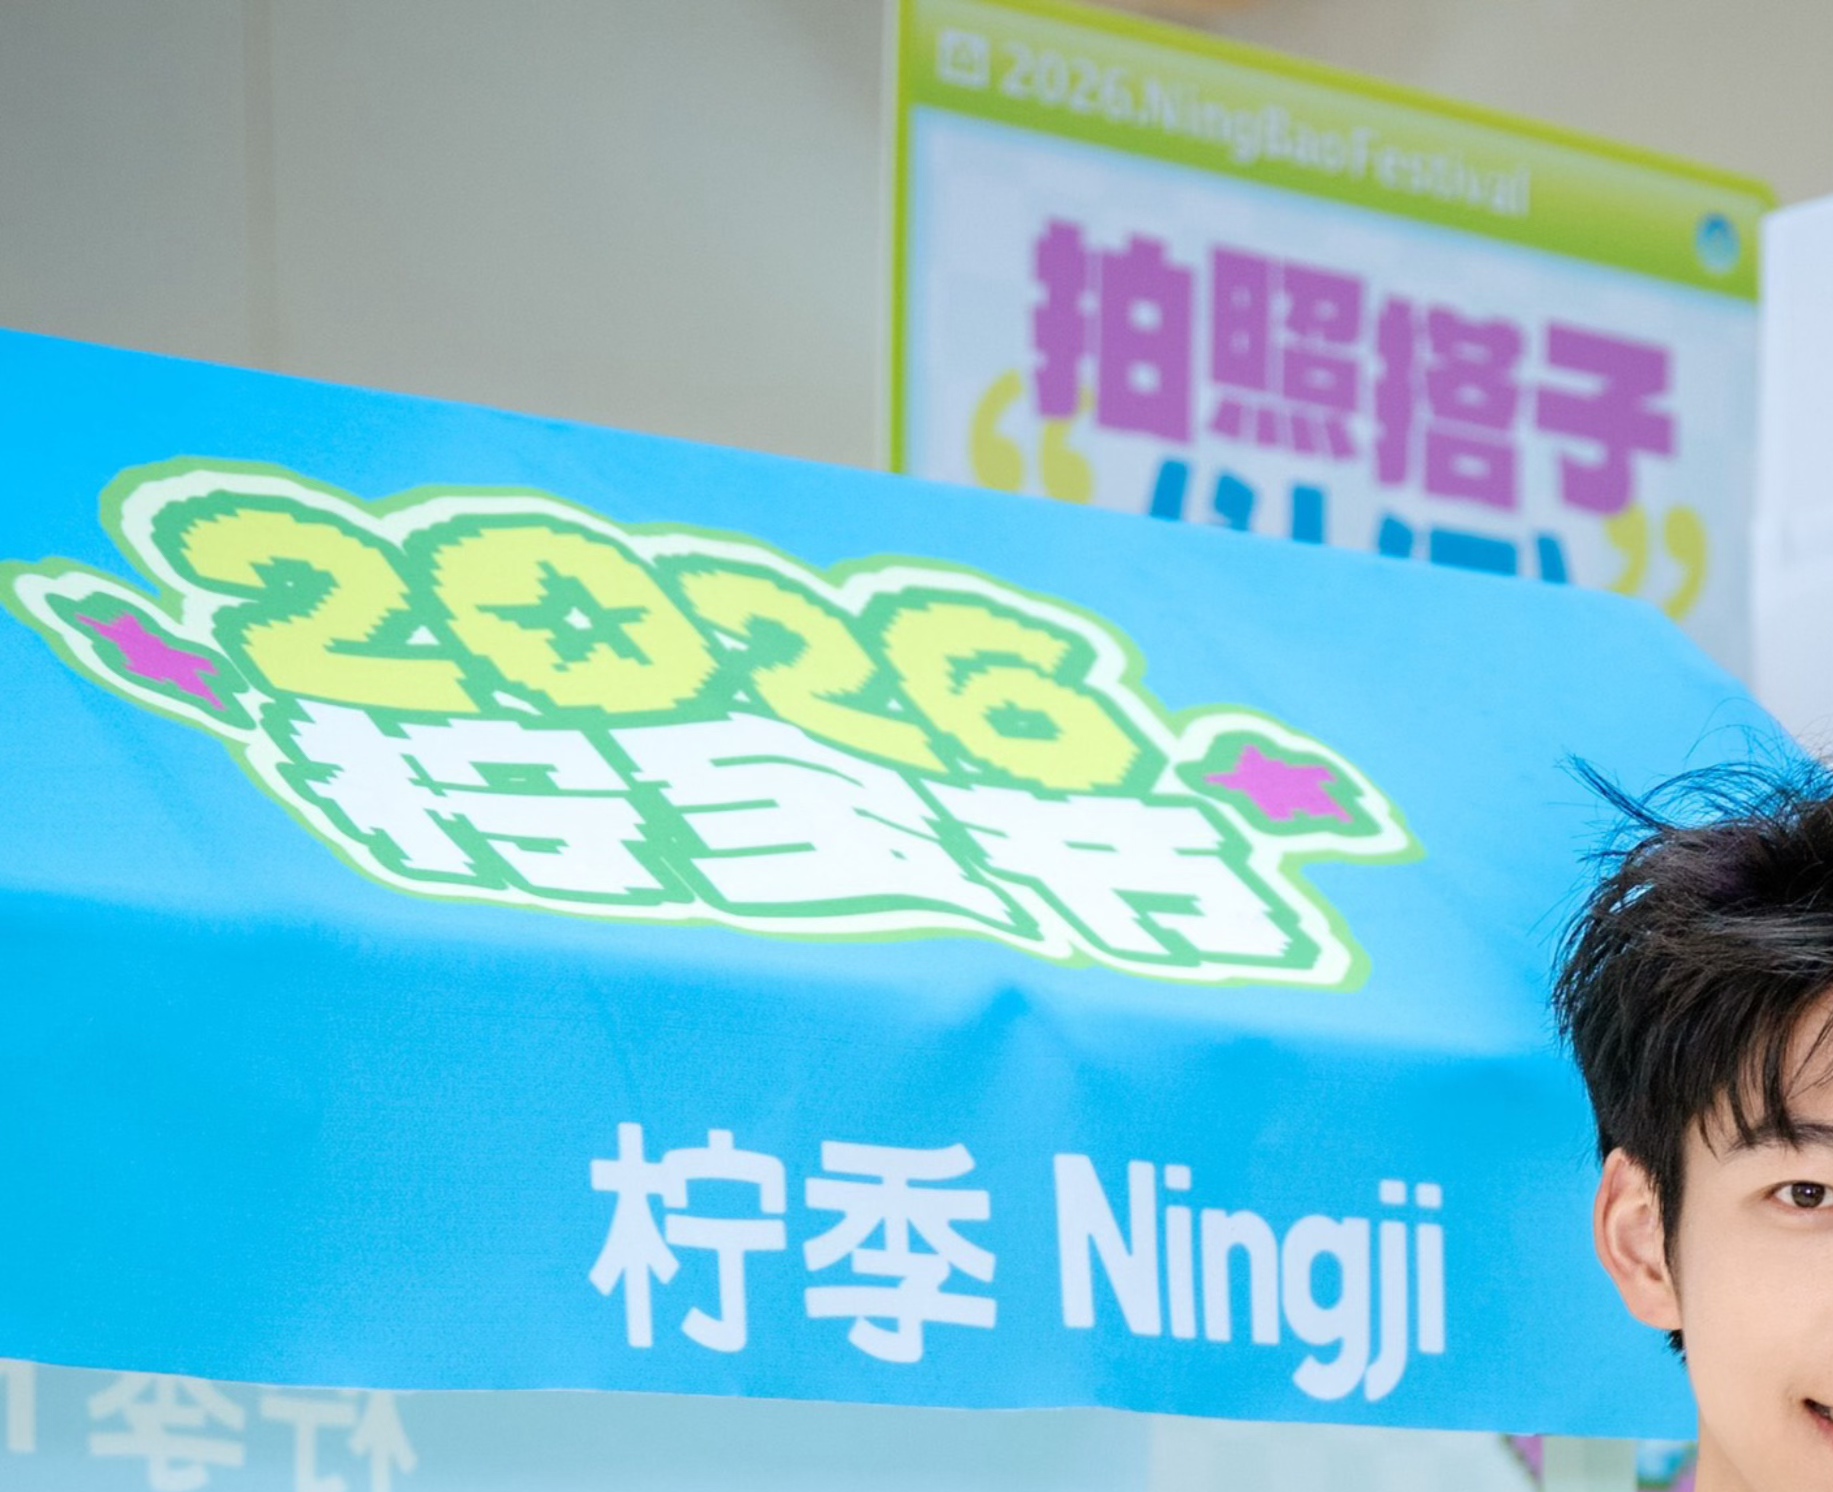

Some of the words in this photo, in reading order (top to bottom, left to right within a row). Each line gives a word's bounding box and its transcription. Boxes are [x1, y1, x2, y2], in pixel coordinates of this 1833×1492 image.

[1032, 217, 1676, 516] 拍照搭子
[180, 507, 1142, 792] 2026
[589, 1123, 997, 1363] 柠季
[1053, 1153, 1445, 1400] Ningji
